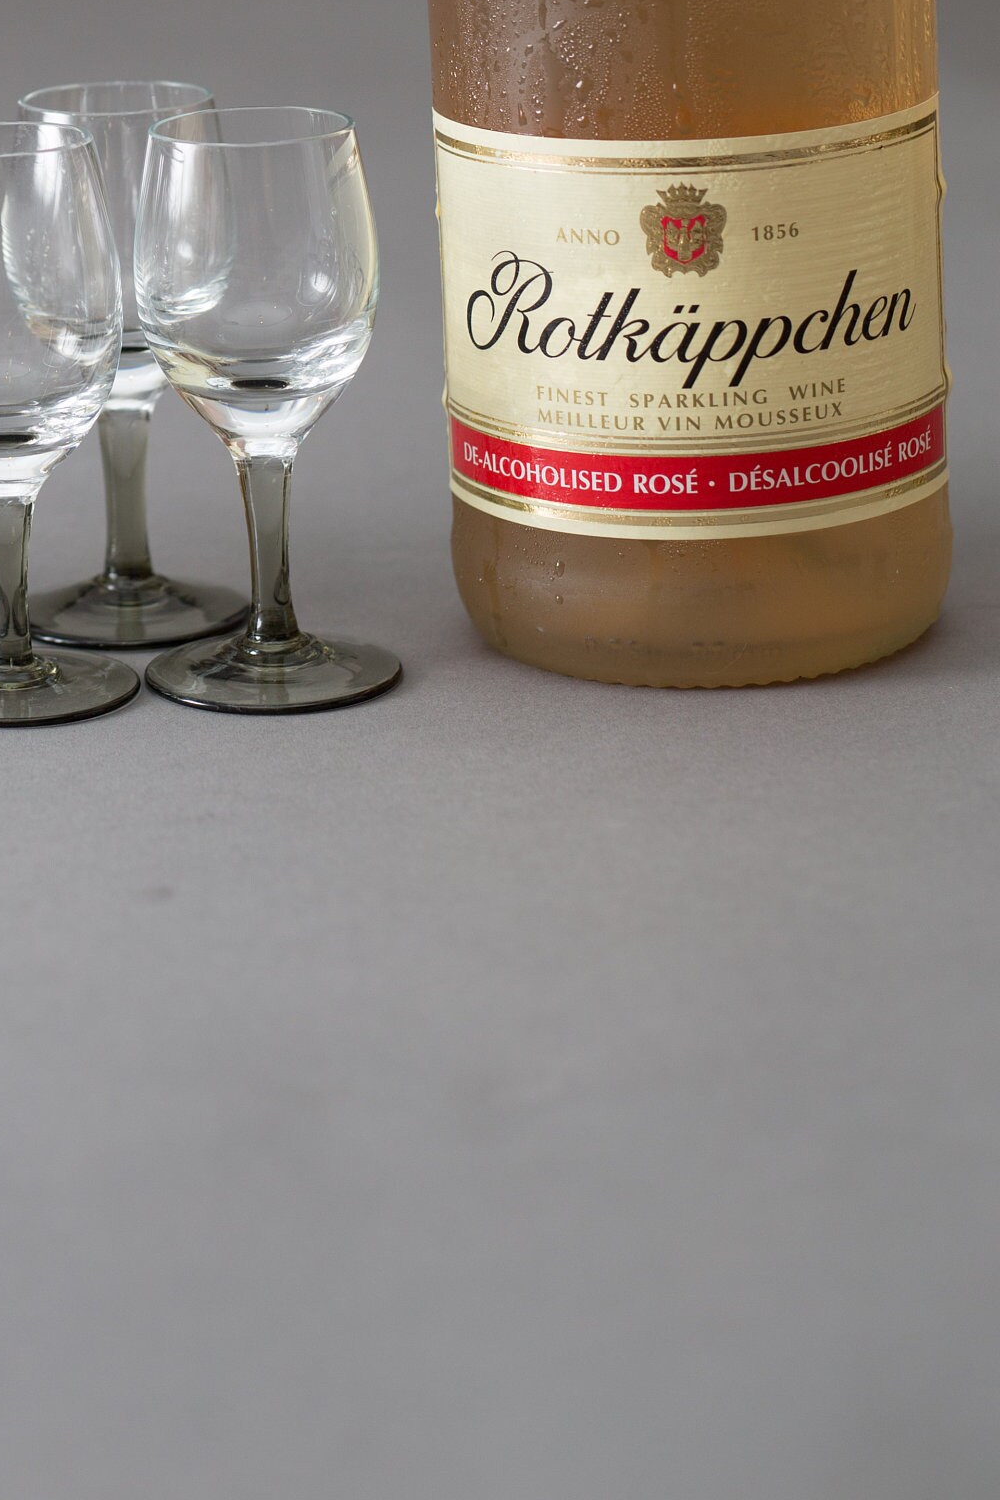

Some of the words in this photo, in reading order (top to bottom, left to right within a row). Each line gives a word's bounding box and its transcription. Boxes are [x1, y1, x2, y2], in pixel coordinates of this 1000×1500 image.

[556, 226, 621, 246] ANNO
[752, 223, 800, 242] 1856
[466, 250, 917, 389] Rotkäppchen
[536, 384, 608, 407] FINEST
[629, 388, 768, 409] SPARKLING
[788, 378, 847, 400] WINE
[537, 408, 645, 431] MEILLEUR
[657, 413, 702, 431] VIN
[715, 402, 844, 430] MOUSSEUX
[464, 440, 623, 493] DE-ALCOHOLISED
[633, 467, 699, 495] ROSÉ
[728, 441, 894, 493] DÉSALCOOLISÉ
[898, 424, 932, 462] ROSÉ
